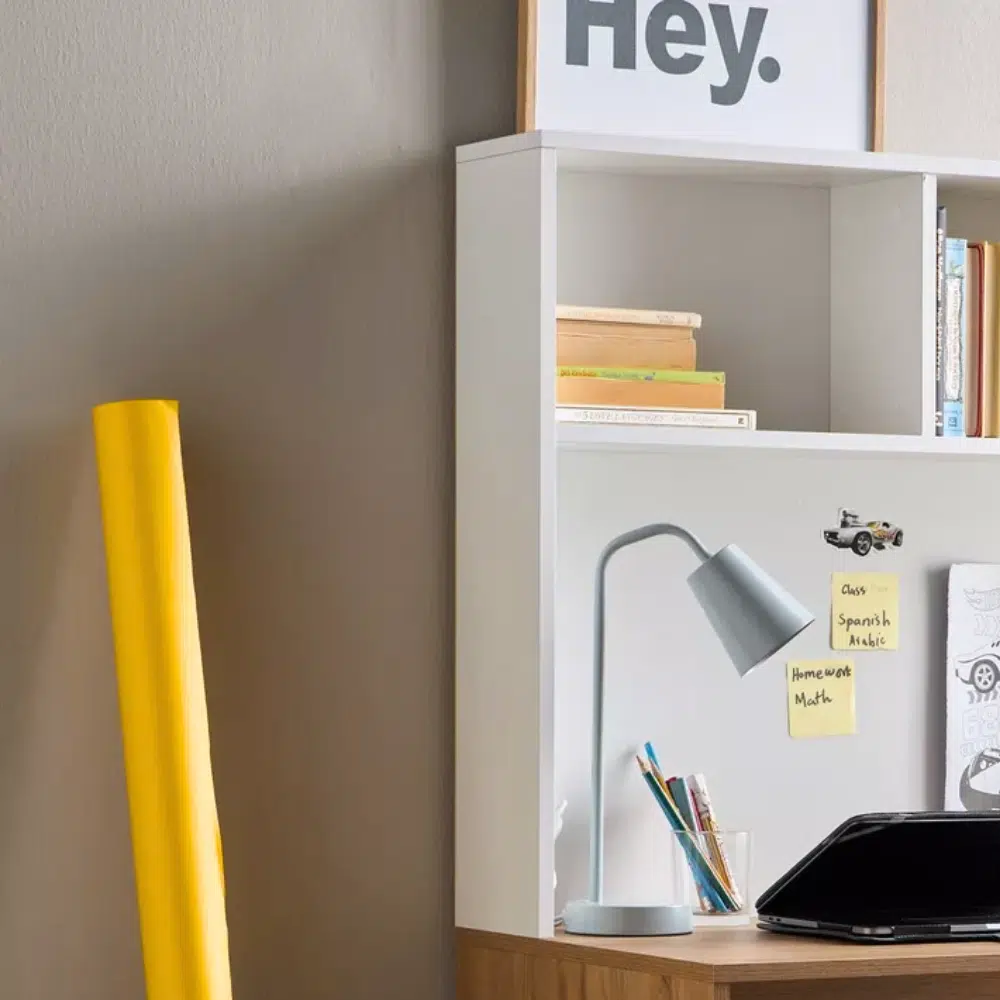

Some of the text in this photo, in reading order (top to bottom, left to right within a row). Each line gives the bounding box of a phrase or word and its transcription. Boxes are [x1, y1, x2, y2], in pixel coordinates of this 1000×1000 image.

[566, 0, 781, 106] Hey.
[841, 583, 867, 596] Class
[837, 608, 891, 633] Spanish
[848, 632, 887, 648] Arabic
[792, 666, 852, 682] Homework
[794, 688, 833, 708] Math
